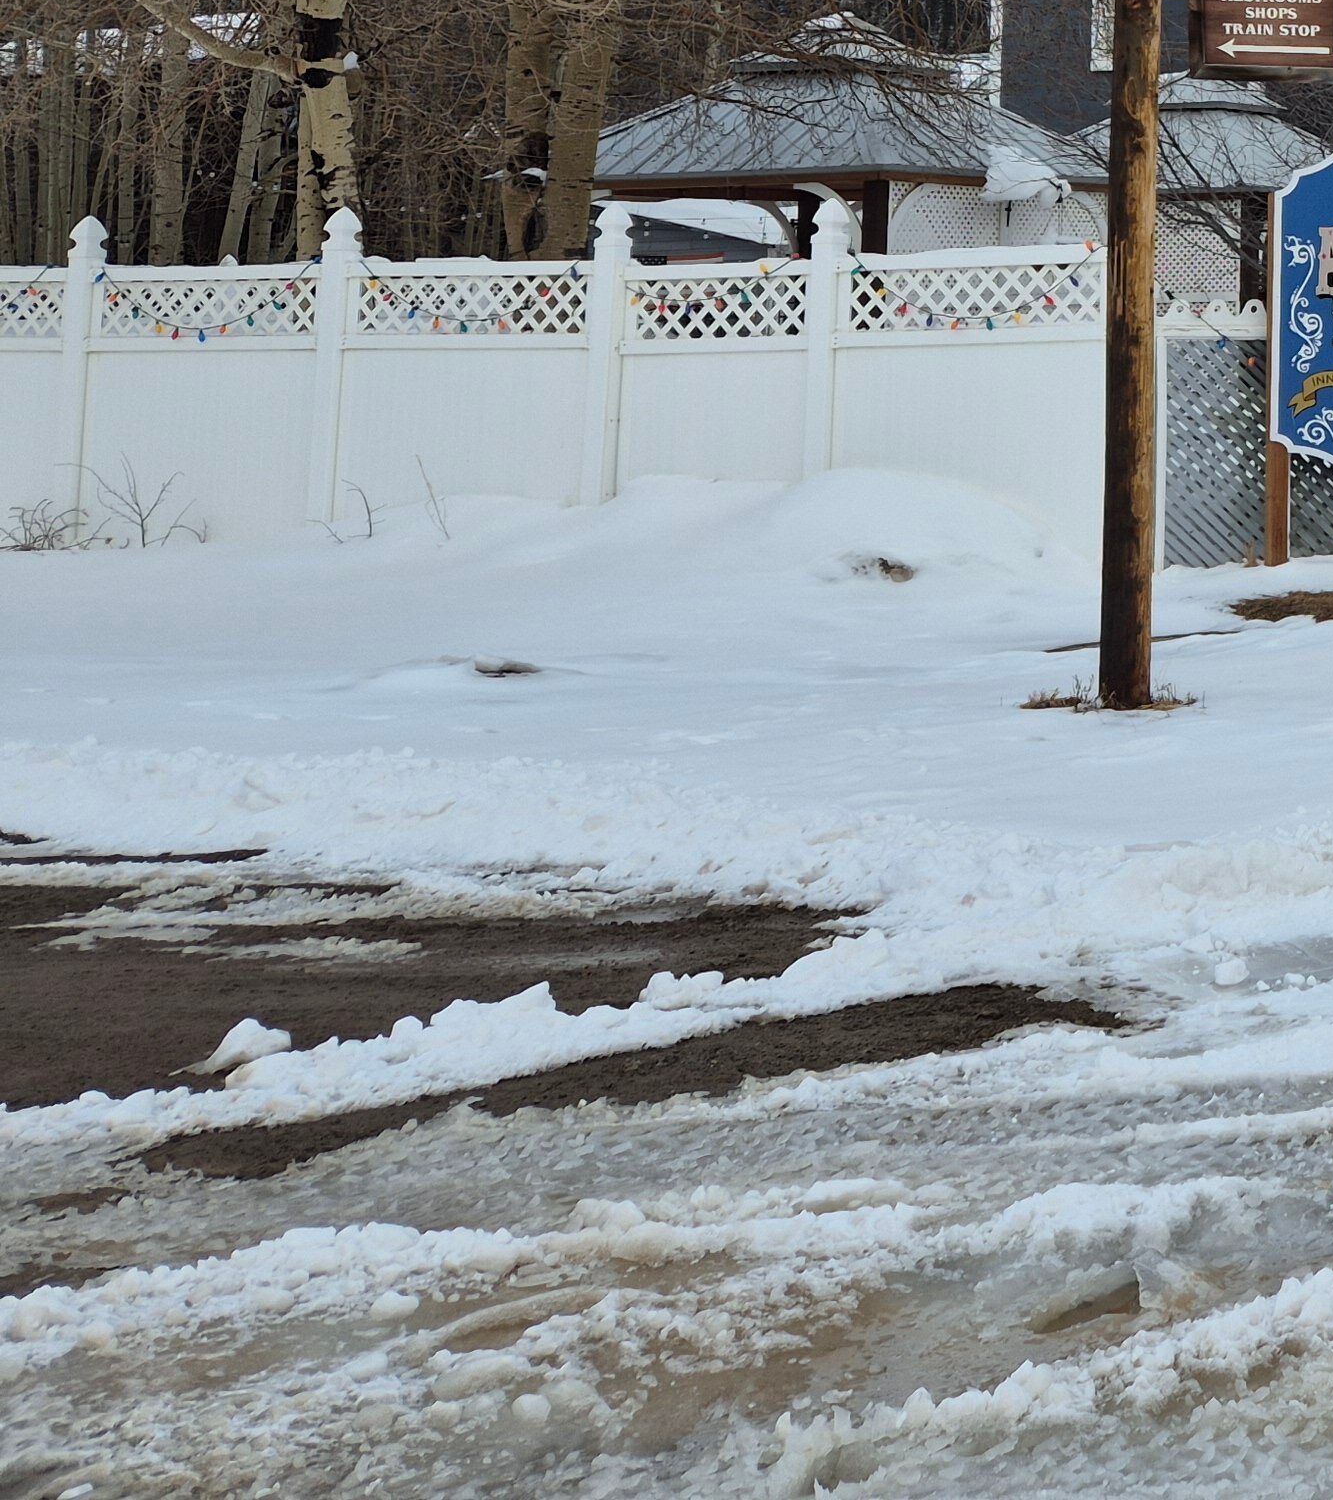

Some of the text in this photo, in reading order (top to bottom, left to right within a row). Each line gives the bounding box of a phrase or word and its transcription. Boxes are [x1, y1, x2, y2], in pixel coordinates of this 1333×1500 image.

[1245, 7, 1298, 20] SHOPS
[1222, 23, 1321, 37] TRAIN STOP
